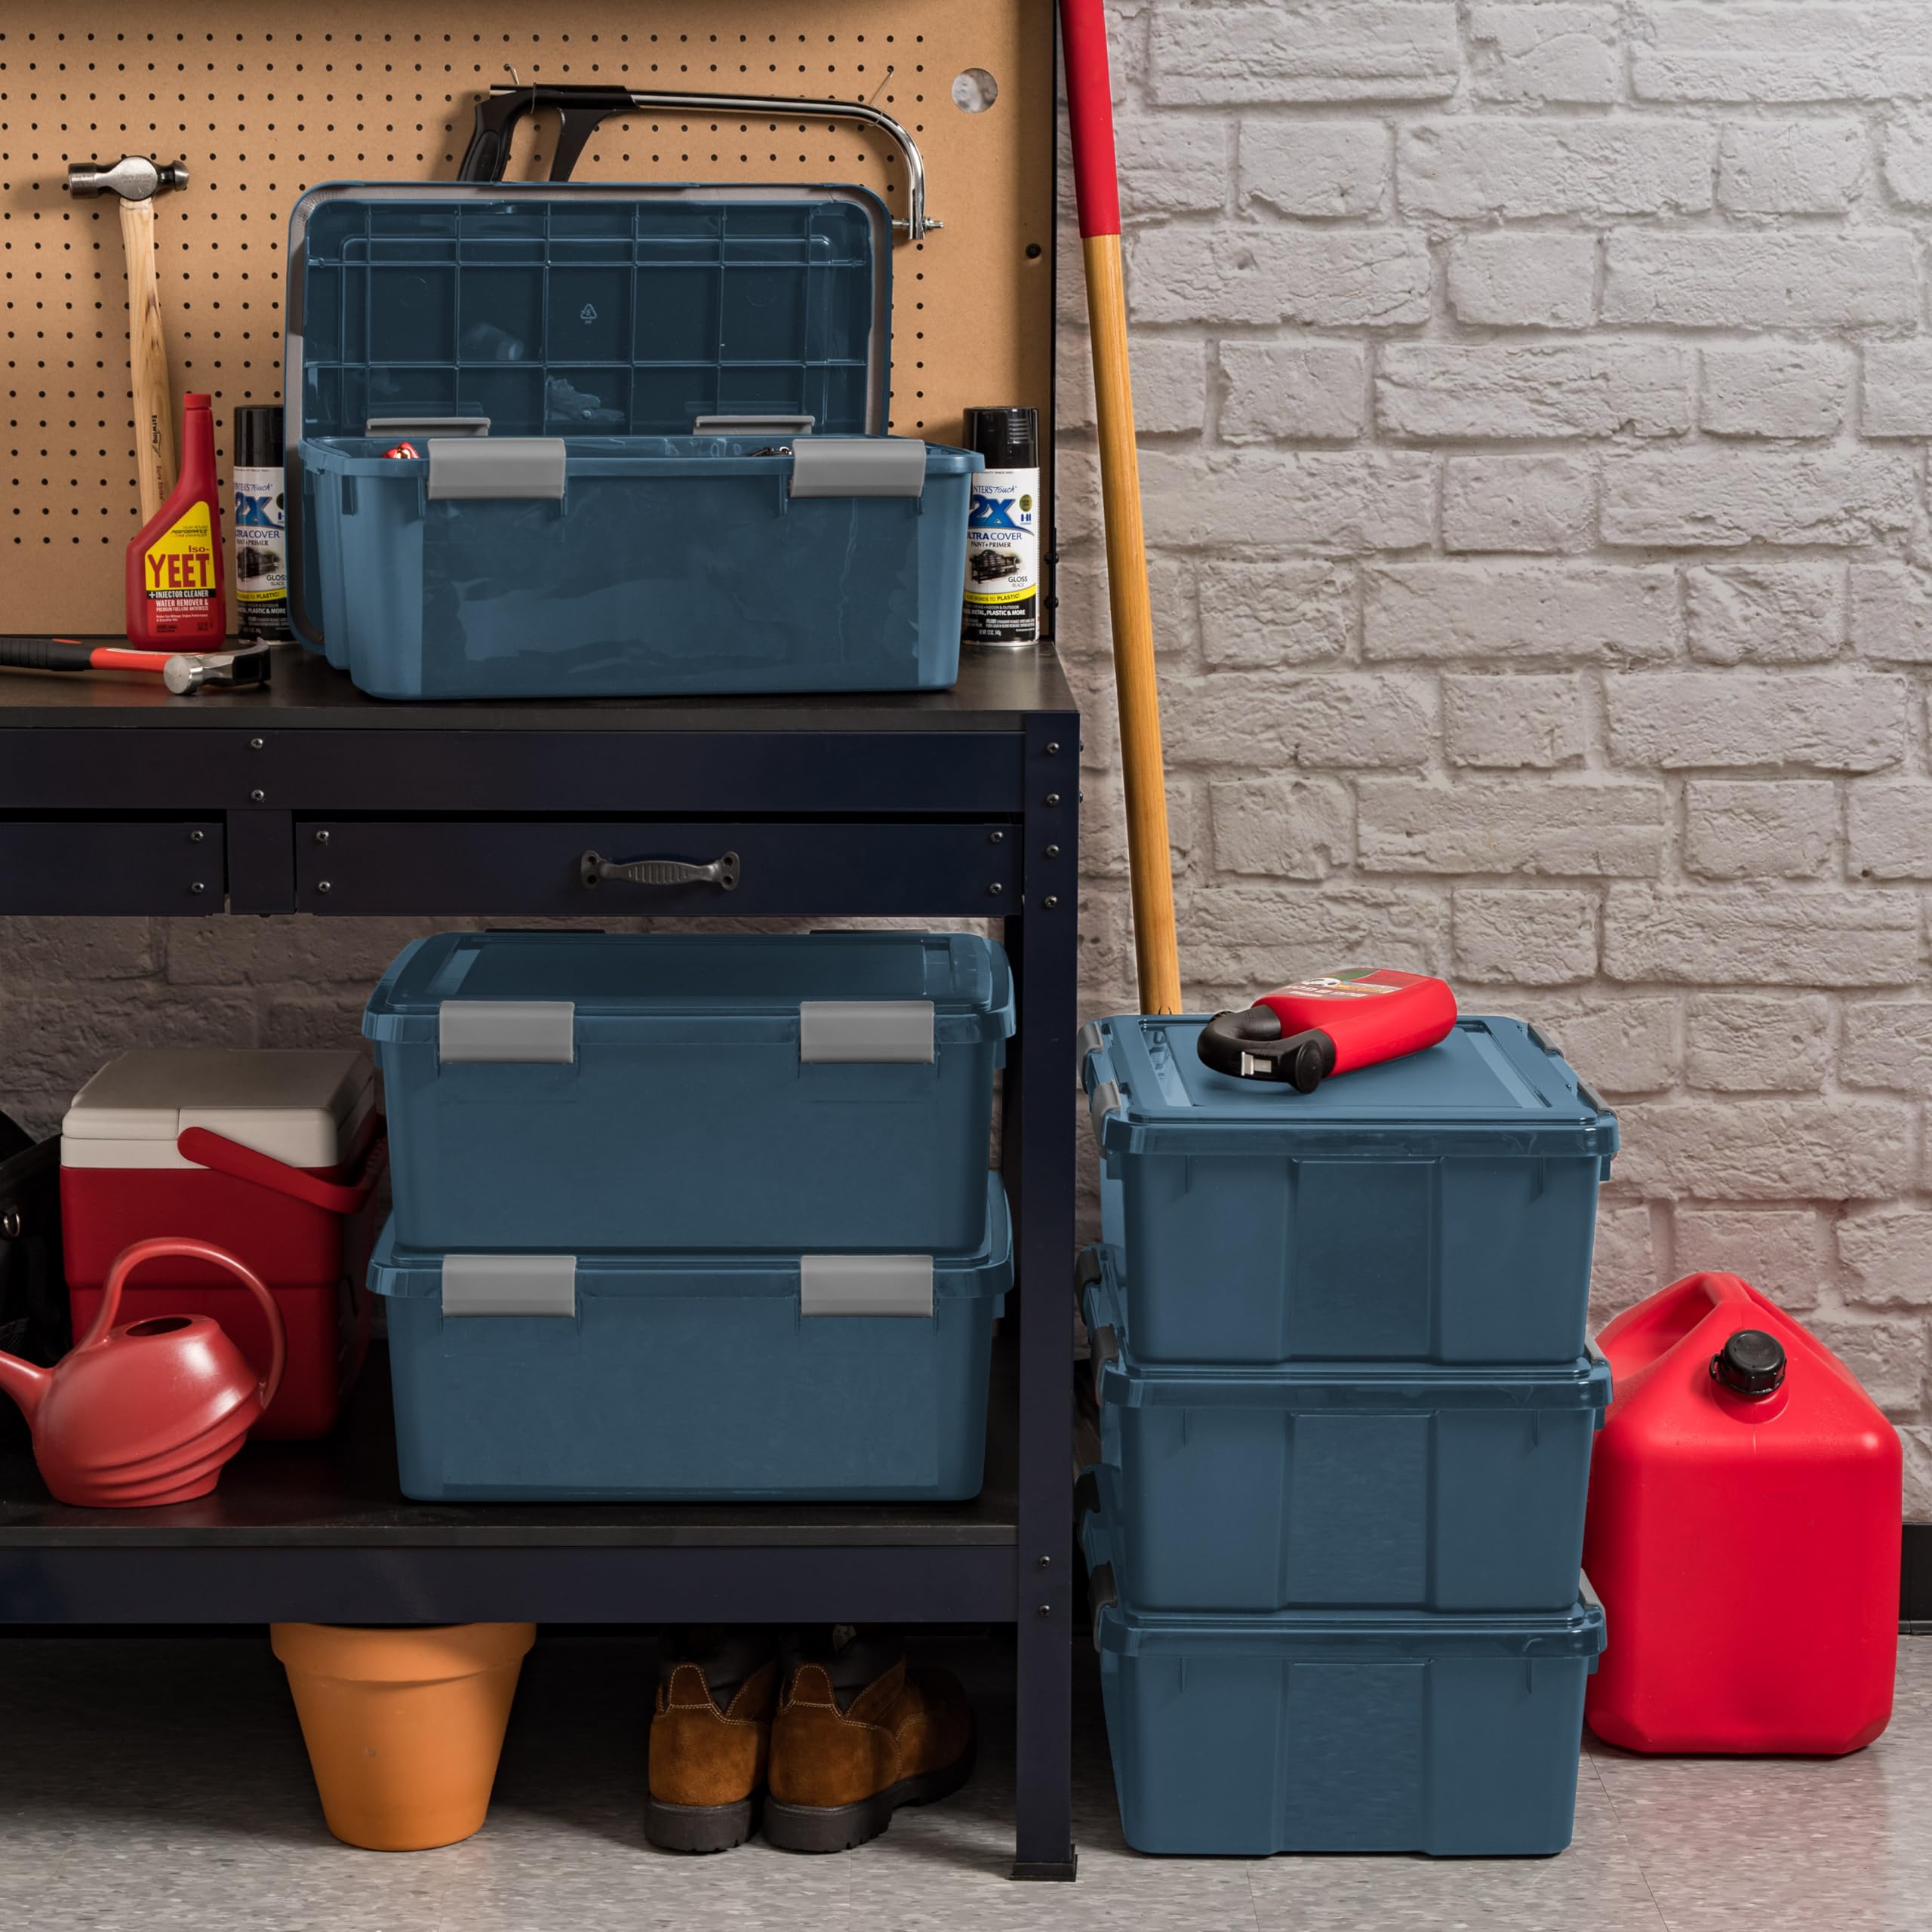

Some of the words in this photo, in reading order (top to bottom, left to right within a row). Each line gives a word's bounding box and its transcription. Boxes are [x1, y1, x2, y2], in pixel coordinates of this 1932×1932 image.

[250, 482, 271, 492] Touch
[992, 485, 1015, 494] Touch
[968, 494, 1016, 528] 2X
[248, 530, 280, 539] COVER
[990, 532, 1022, 540] COVER
[188, 545, 210, 553] Iso-
[147, 553, 210, 589] YEET
[183, 589, 209, 598] CLEANER
[177, 598, 203, 607] REMOVER
